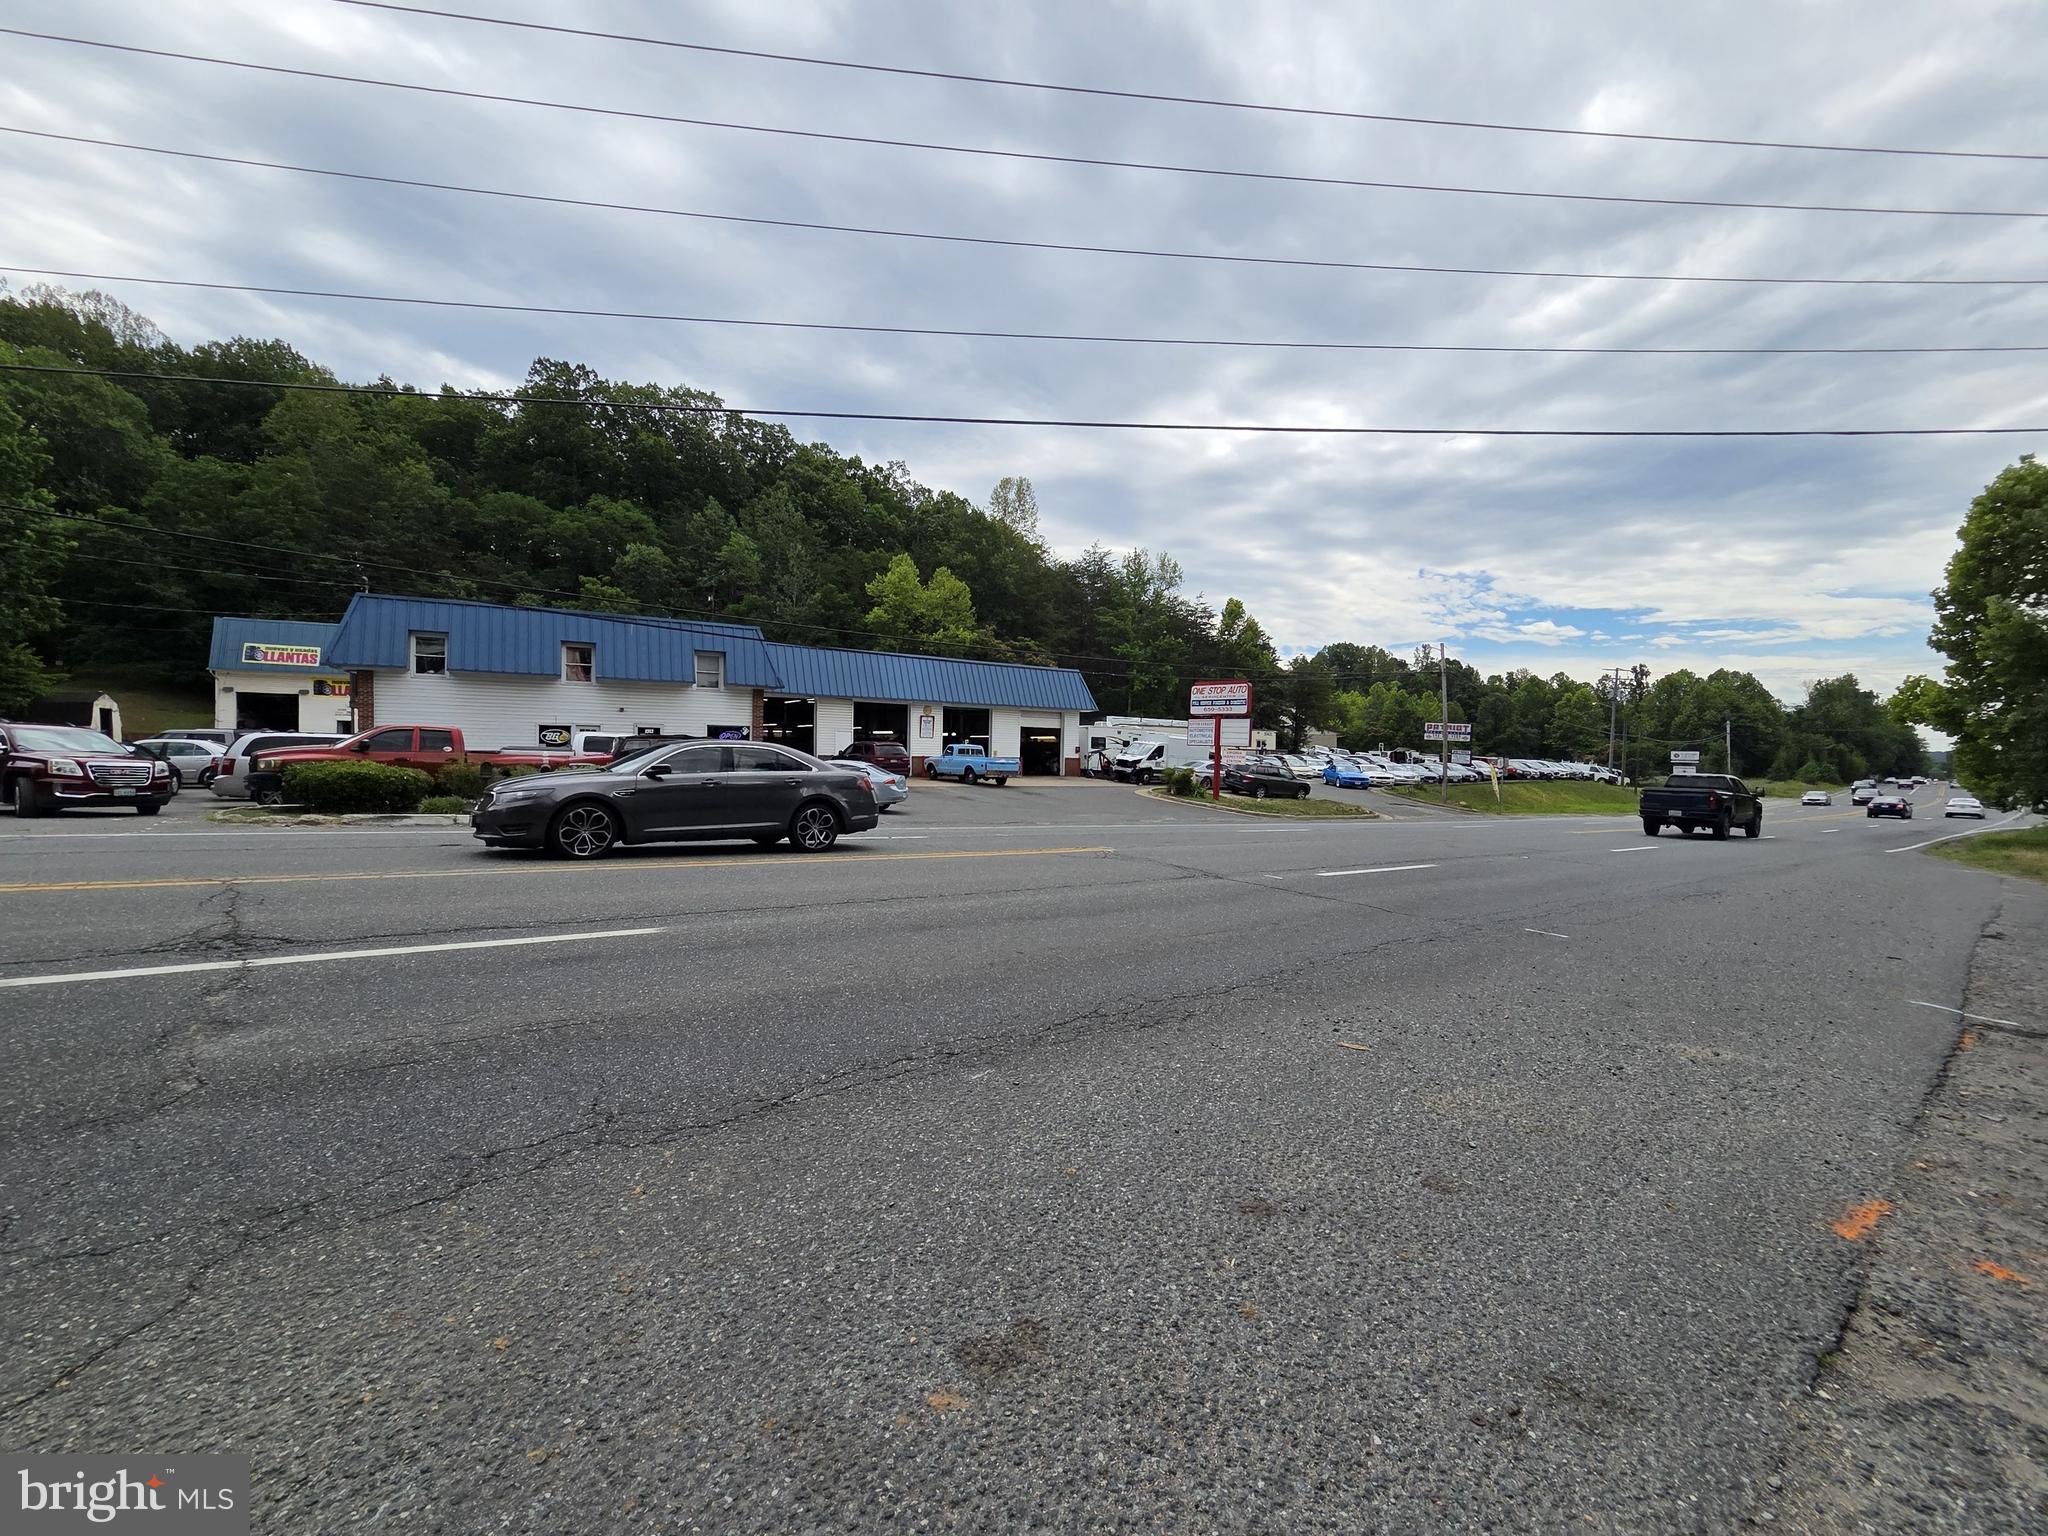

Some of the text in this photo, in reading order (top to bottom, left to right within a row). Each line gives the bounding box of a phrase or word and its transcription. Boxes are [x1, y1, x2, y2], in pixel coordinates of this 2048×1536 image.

[264, 651, 318, 664] LLANTAS
[1192, 685, 1247, 695] ONE STOP AUTO
